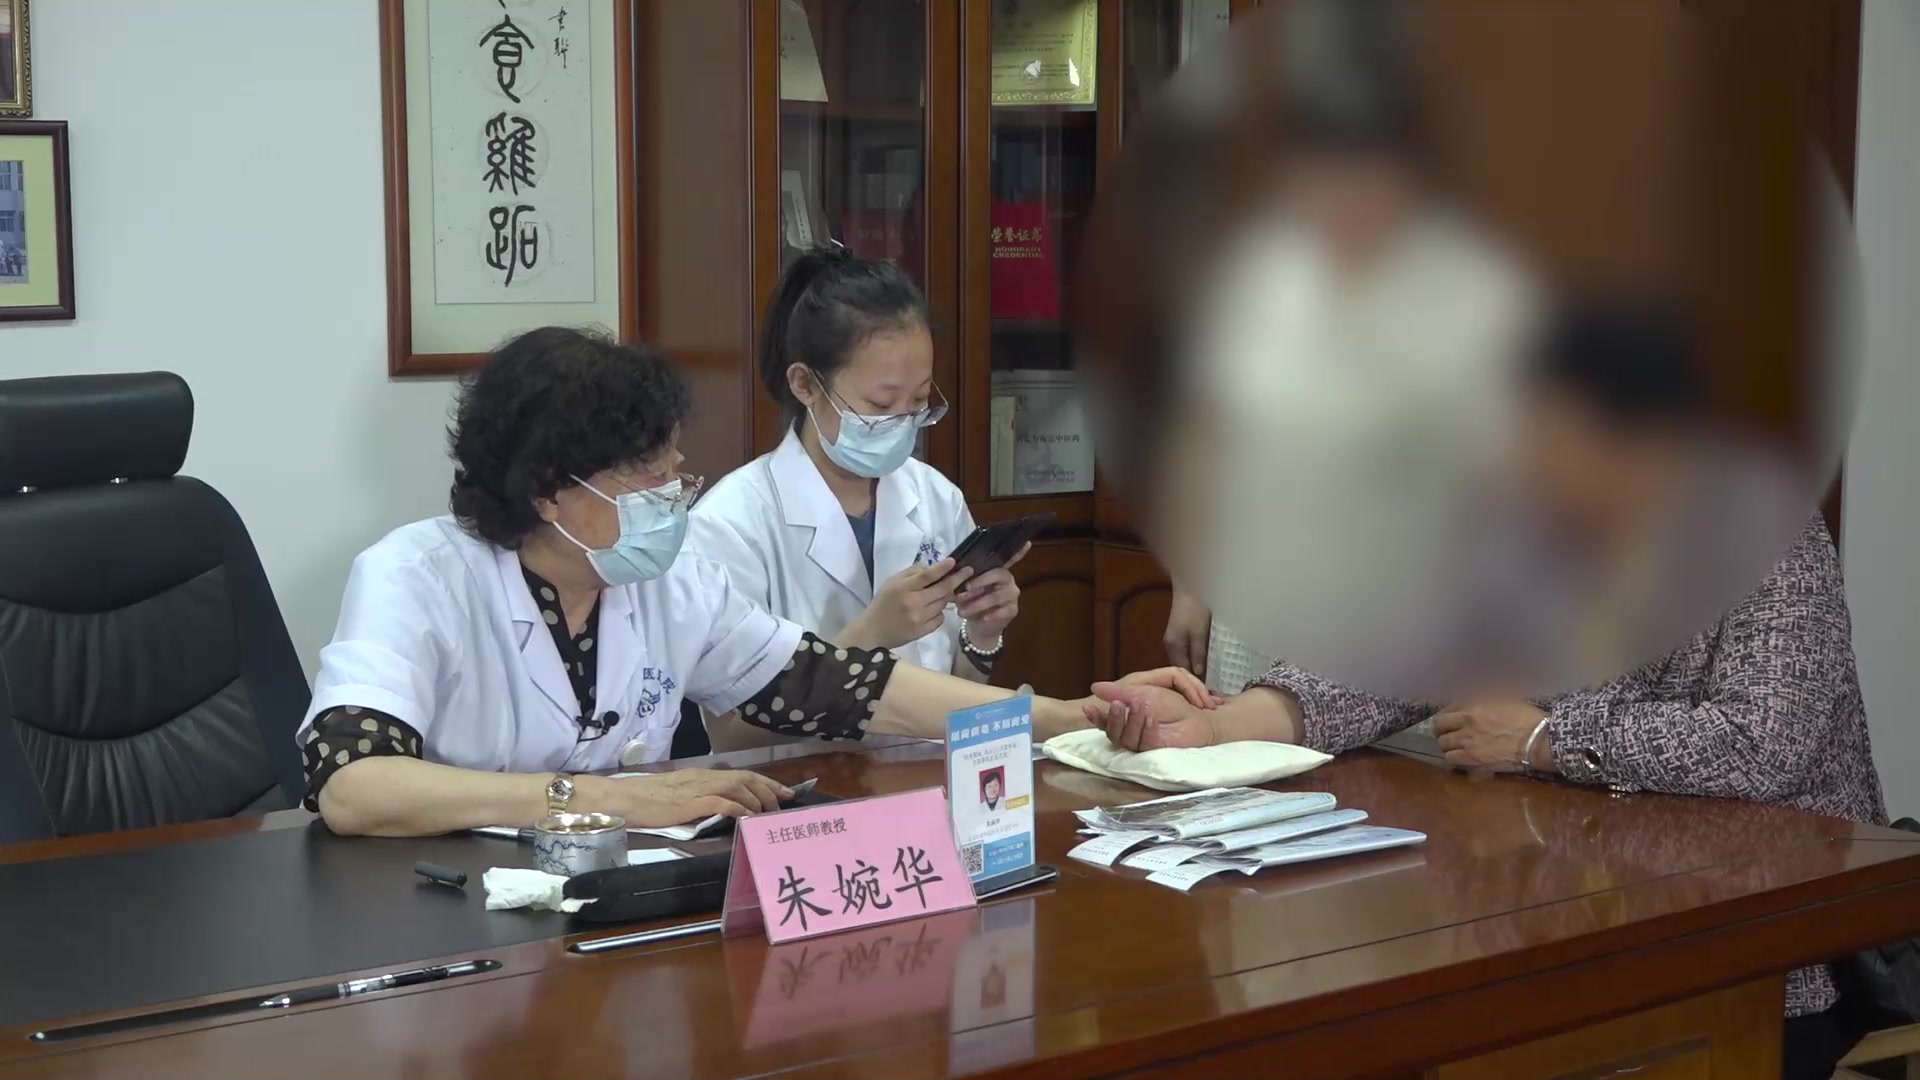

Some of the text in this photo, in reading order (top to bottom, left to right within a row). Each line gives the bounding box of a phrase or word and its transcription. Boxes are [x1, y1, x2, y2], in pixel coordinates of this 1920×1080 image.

[479, 0, 538, 288] 食雞跖
[991, 226, 1042, 243] 荣誉证书
[766, 817, 848, 845] 主任医师教授
[776, 846, 943, 932] 朱婉华
